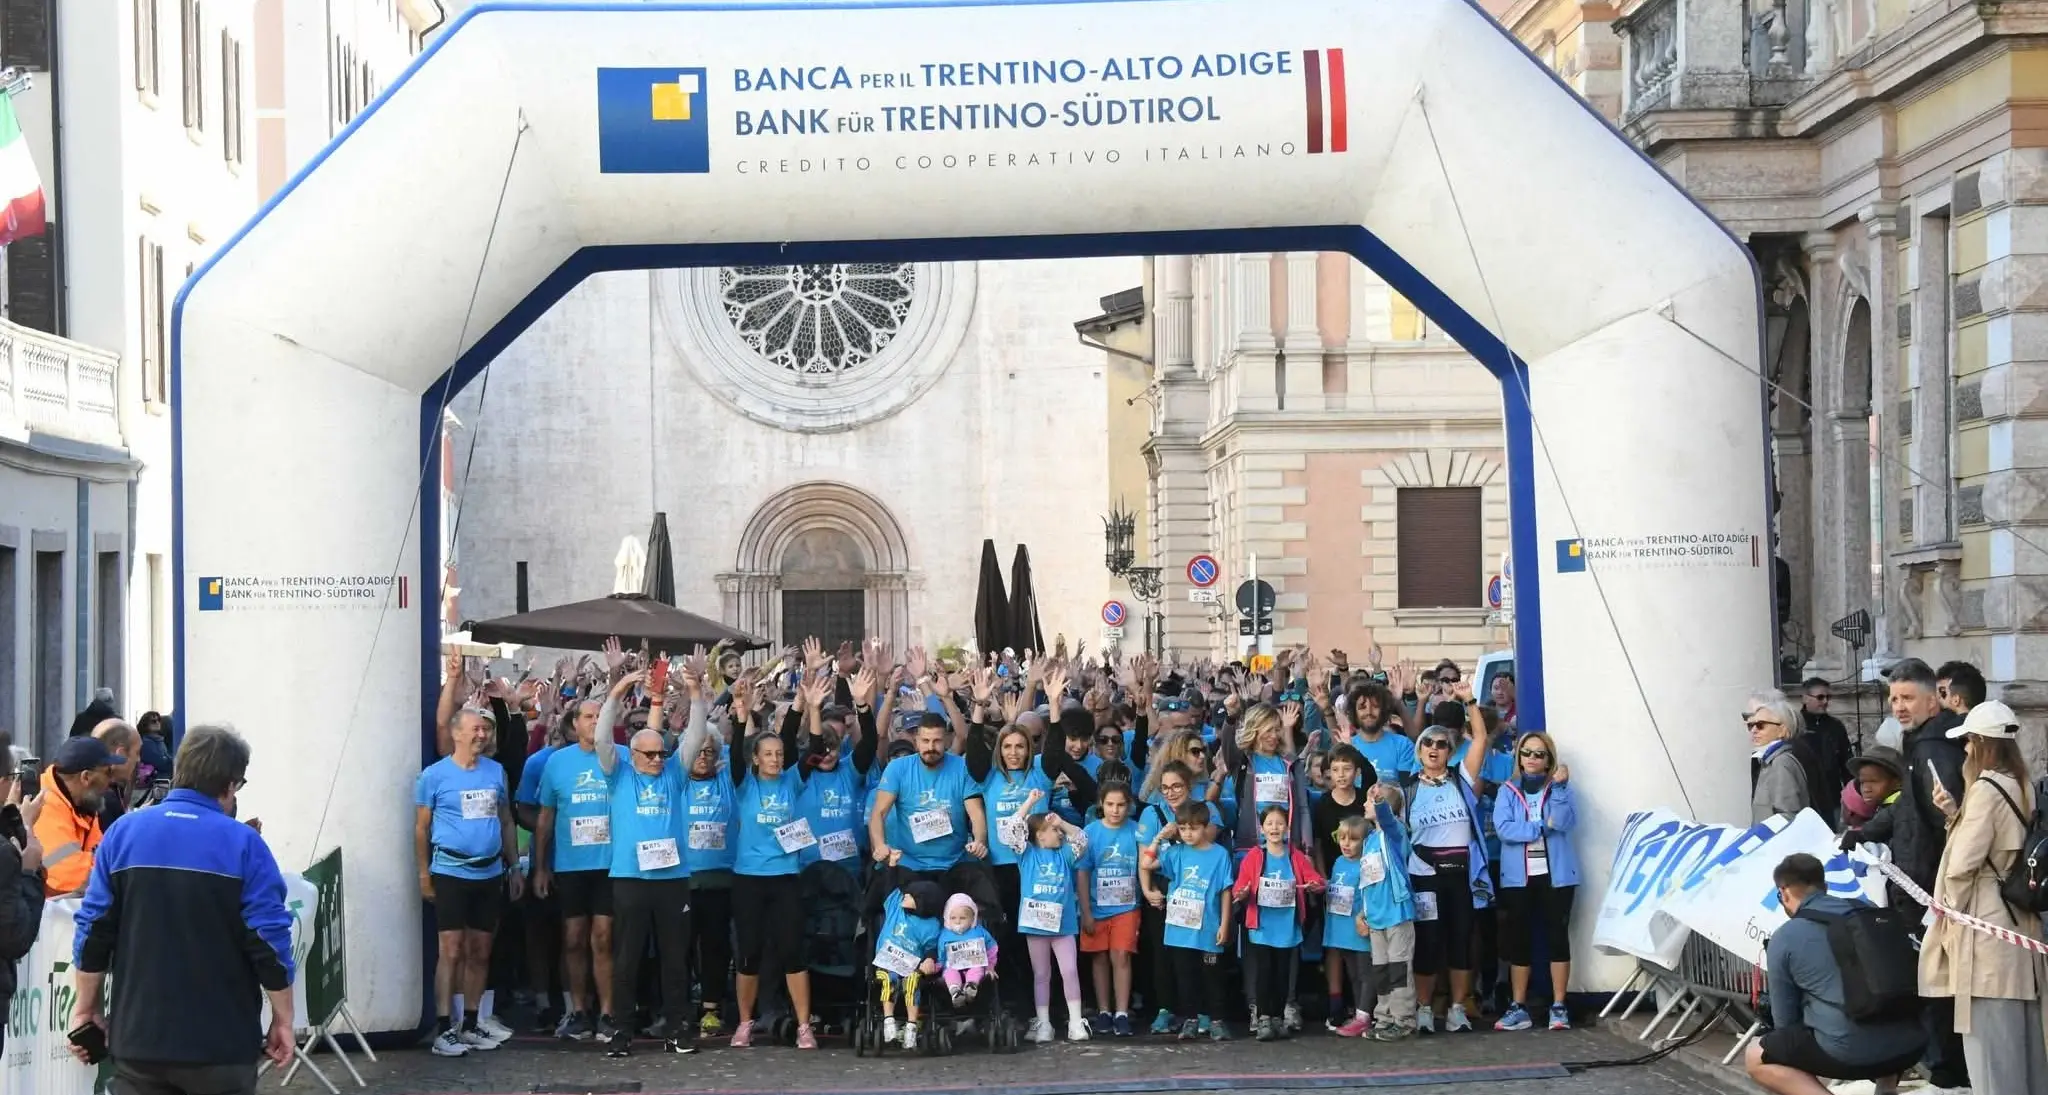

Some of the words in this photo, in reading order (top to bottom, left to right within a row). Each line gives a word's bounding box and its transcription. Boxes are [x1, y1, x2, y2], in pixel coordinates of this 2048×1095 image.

[734, 66, 853, 92] BANCA
[860, 73, 895, 89] PER
[900, 73, 915, 88] IL
[920, 55, 1183, 87] TRENTINO-ALTO
[1191, 51, 1292, 78] ADIGE
[735, 108, 830, 136] BANK
[837, 112, 875, 133] FÜR
[881, 92, 1221, 132] TRENTINO-SÜDTIROL
[736, 157, 871, 174] CREDITO
[895, 149, 1120, 170] COOPERATIVO
[1145, 142, 1295, 162] ITALIANO
[1587, 536, 1624, 548] BANCA
[1646, 534, 1725, 545] TRENTINO-ALTO
[1726, 534, 1749, 543] ADIGE
[1588, 549, 1617, 559] BANK
[1633, 544, 1734, 557] TRENTINO-SÜDTIROL
[225, 577, 260, 587] BANCA
[281, 576, 365, 586] TRENTINO-ALTO
[367, 576, 395, 586] ADIGE
[225, 589, 253, 599] BANK
[268, 586, 376, 599] TRENTINO-SÜDTIROL
[583, 793, 597, 801] BTS
[645, 806, 659, 815] BTS
[699, 806, 714, 814] BTS
